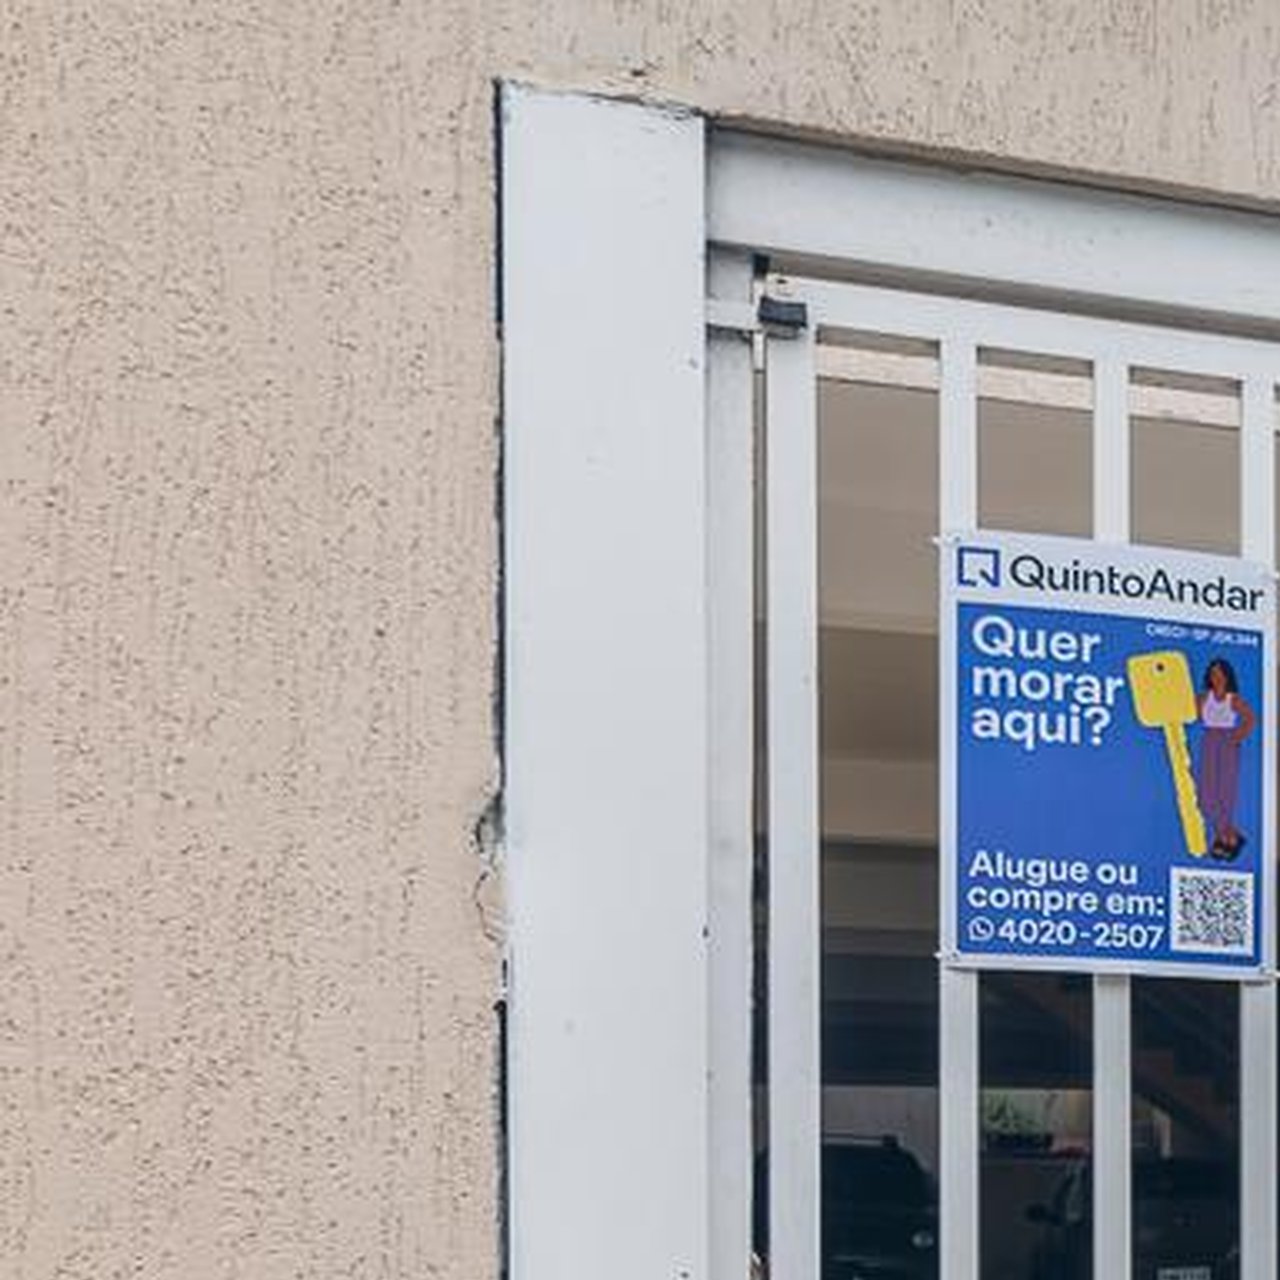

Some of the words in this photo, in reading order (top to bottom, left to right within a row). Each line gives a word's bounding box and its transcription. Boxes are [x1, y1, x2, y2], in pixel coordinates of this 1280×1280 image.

[1009, 555, 1264, 611] QuintoAndar
[971, 615, 1101, 663] Quer
[972, 664, 1124, 705] morar
[971, 704, 1110, 750] aqui?
[968, 850, 1089, 887] Alugue
[1096, 863, 1138, 884] ou
[967, 886, 1098, 917] compre
[1106, 898, 1165, 917] em:
[998, 918, 1164, 949] 4020-2507
